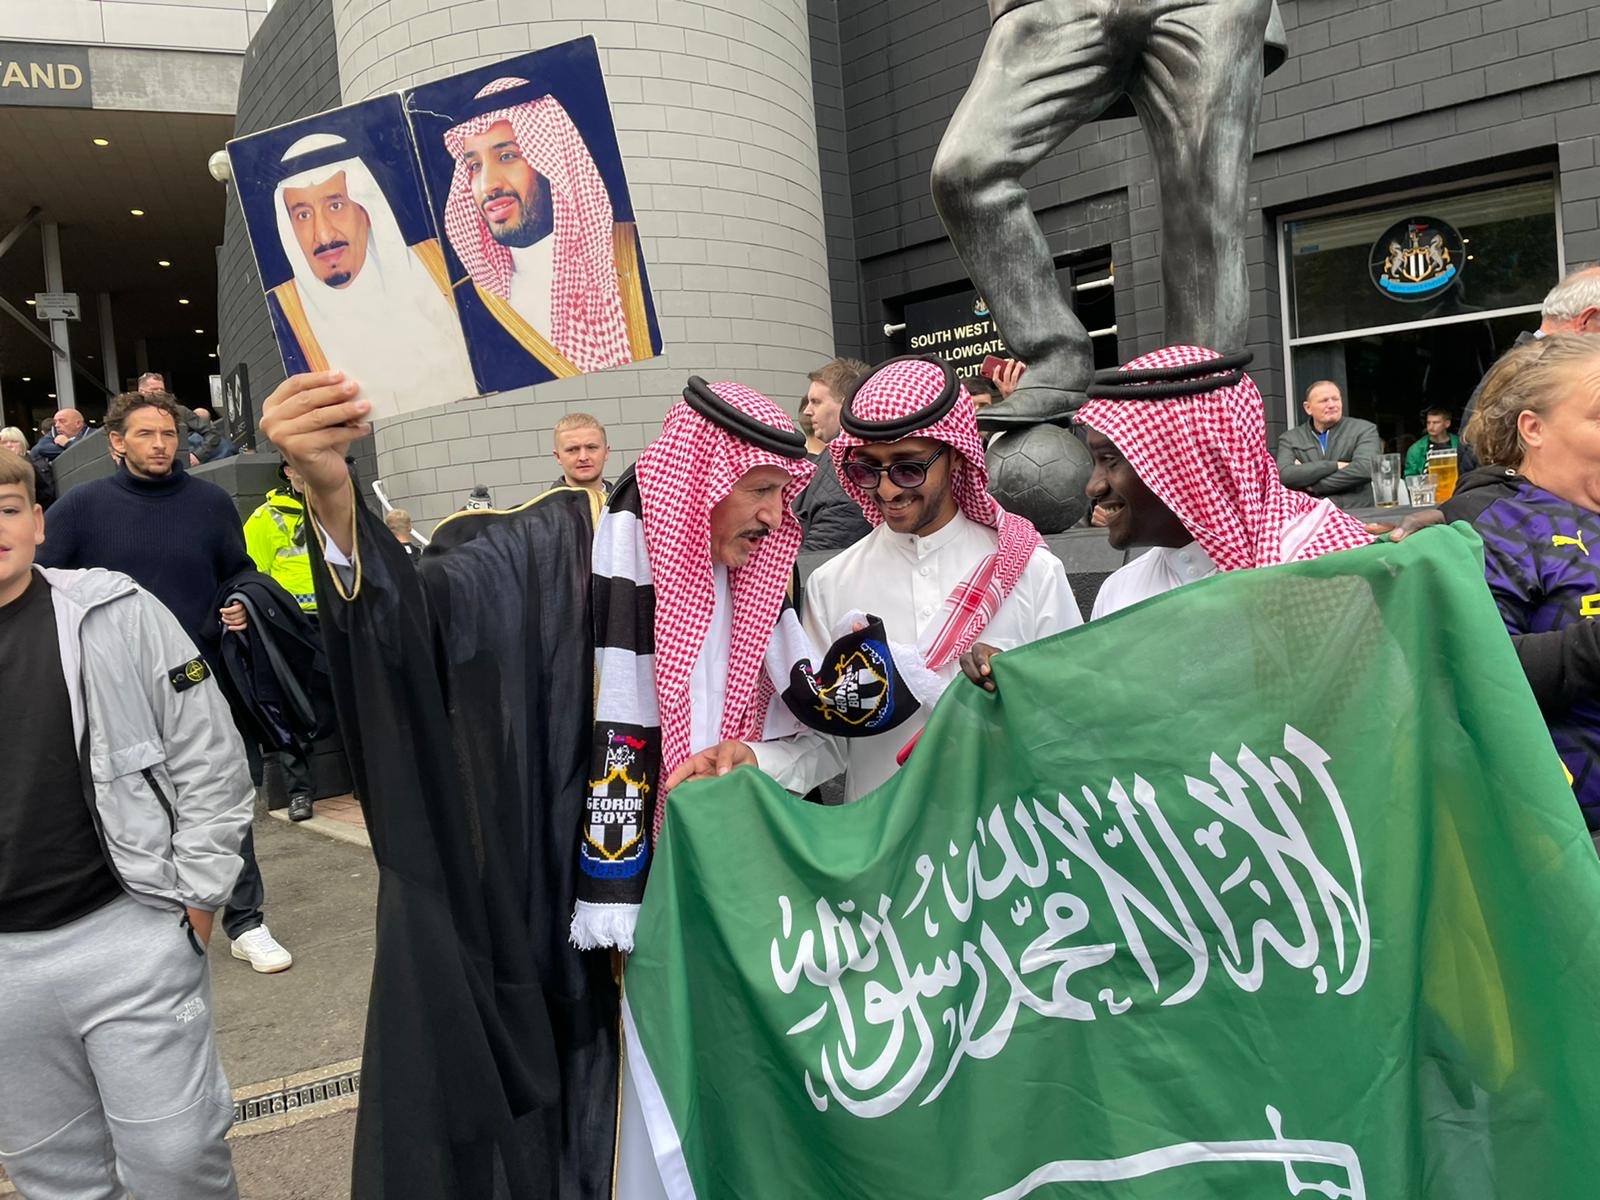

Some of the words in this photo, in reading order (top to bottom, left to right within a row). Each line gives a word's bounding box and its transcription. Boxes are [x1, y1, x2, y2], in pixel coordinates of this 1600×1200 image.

[0, 62, 83, 90] AND
[911, 329, 952, 348] SOUTH
[954, 321, 990, 339] WEST
[587, 797, 643, 811] GEORDIE
[591, 811, 637, 824] BOYS
